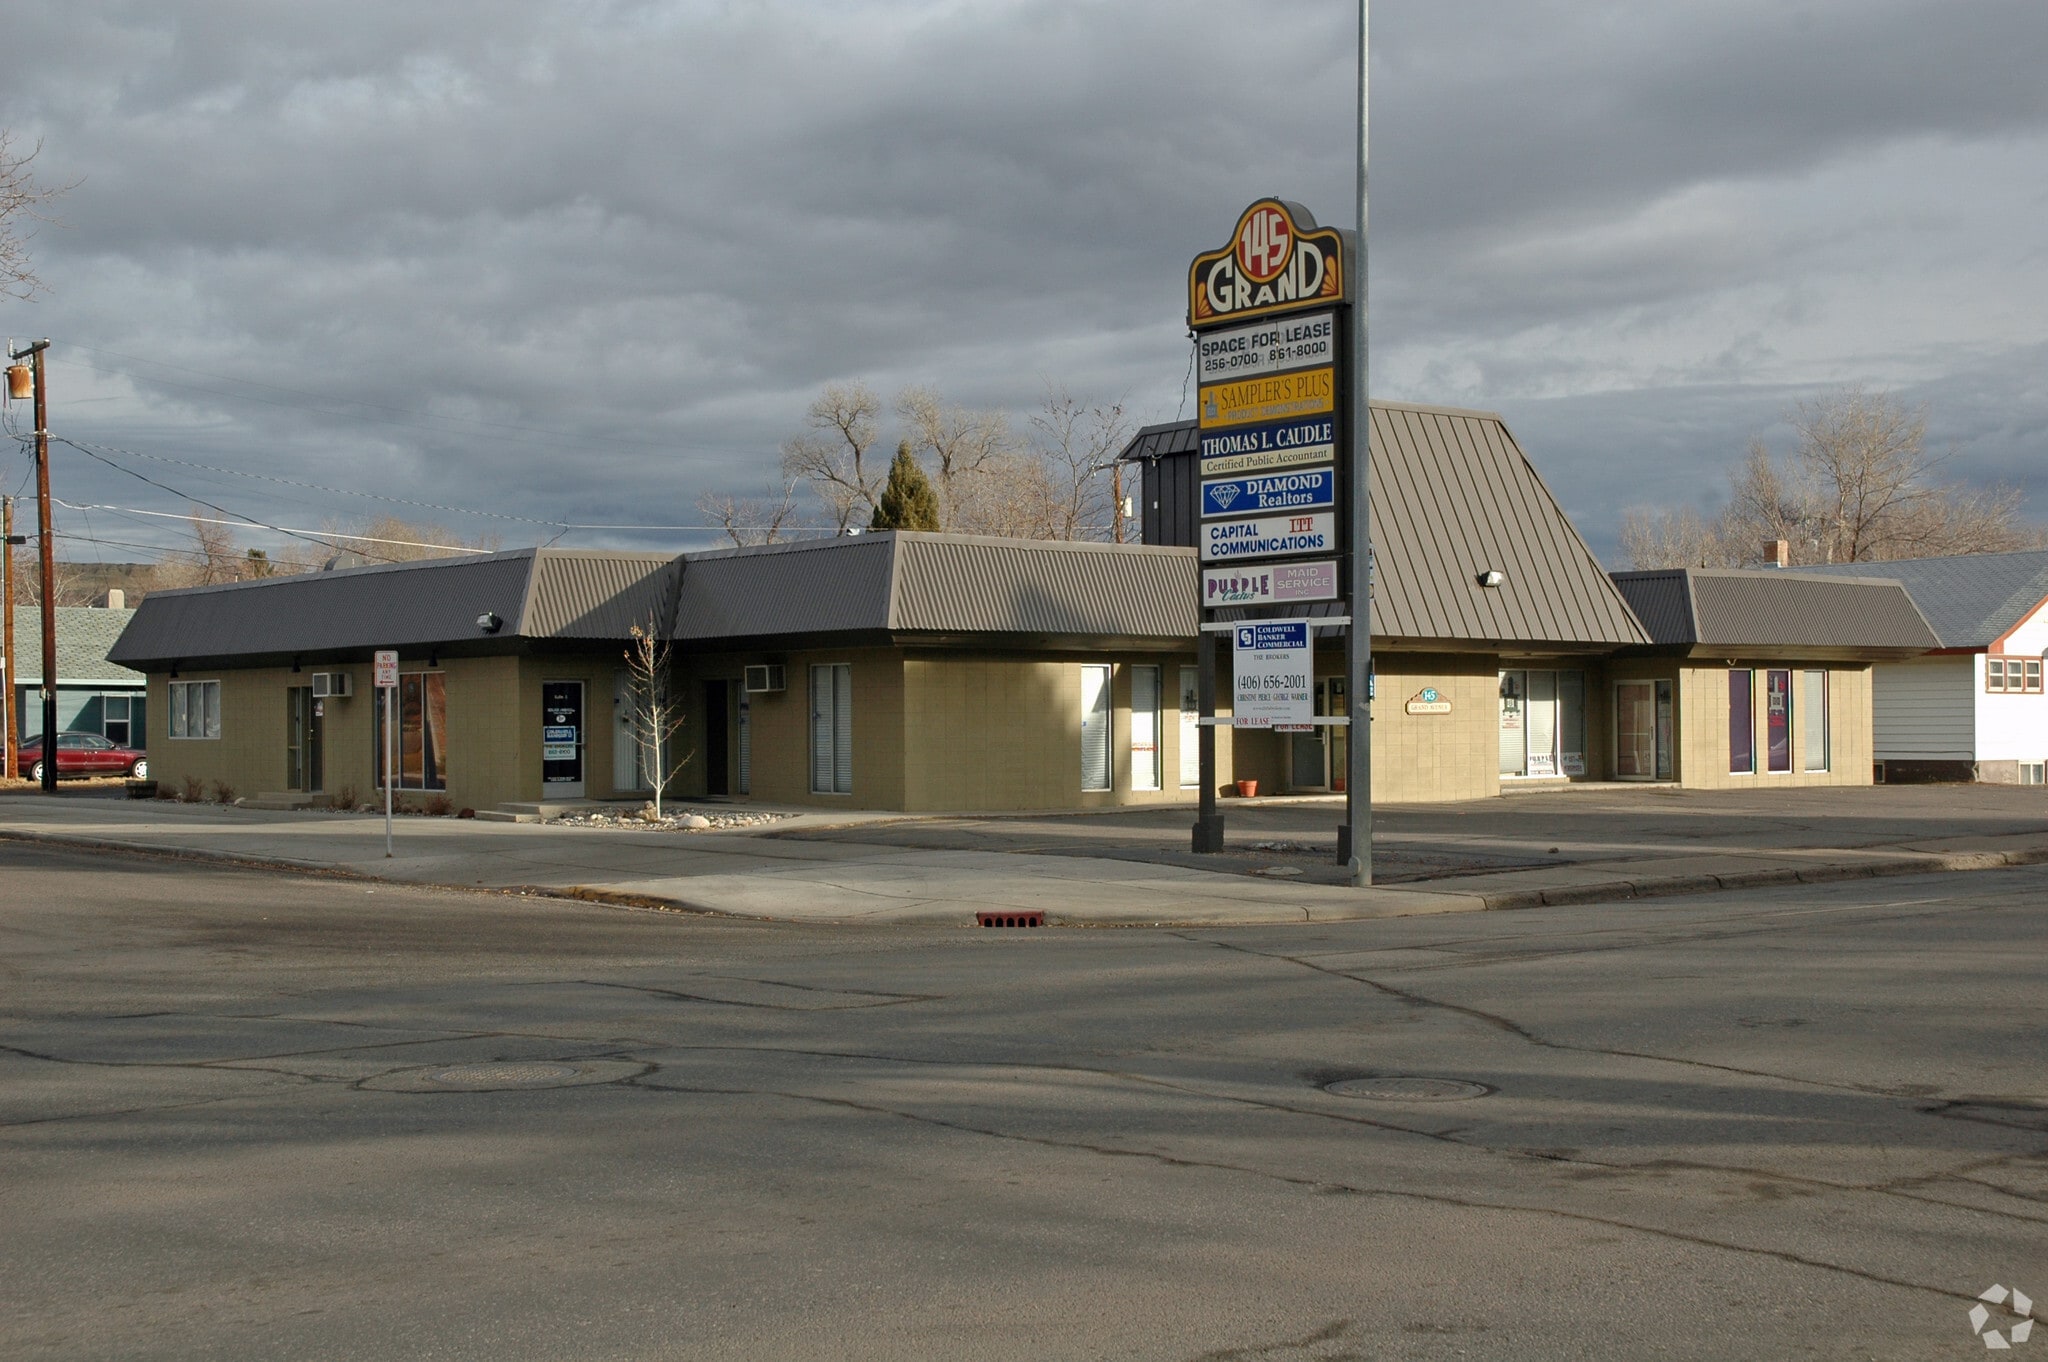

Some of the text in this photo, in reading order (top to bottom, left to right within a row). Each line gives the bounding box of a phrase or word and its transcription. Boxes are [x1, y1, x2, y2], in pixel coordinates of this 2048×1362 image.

[1241, 210, 1288, 276] 145
[1206, 240, 1324, 312] GRAND
[1201, 322, 1331, 357] SPACE FOR LEASE
[1205, 341, 1327, 371] 256-0700 861-8000
[1221, 373, 1330, 410] SAMPLER'S PLUS
[1201, 423, 1332, 456] THOMAS L. CAUDLE
[1206, 449, 1328, 472] Certified Public Accountant
[1246, 474, 1323, 496] DIAMOND
[1258, 491, 1313, 508] Realtors
[1210, 524, 1259, 540] CAPITAL
[1288, 517, 1314, 534] ITT
[1210, 534, 1324, 557] COMMUNICATIONS
[1287, 567, 1319, 578] MAID
[1207, 574, 1269, 598] PURPLE
[1277, 577, 1330, 589] SERVICE
[1221, 589, 1256, 602] Cactus
[1257, 626, 1296, 634] COLDWELL
[1257, 633, 1286, 641] BANKER
[1257, 640, 1305, 649] COMMERCIAL
[1238, 674, 1306, 690] (406) 656-2001
[1424, 690, 1436, 701] 145
[1236, 717, 1270, 726] FOR LEASE
